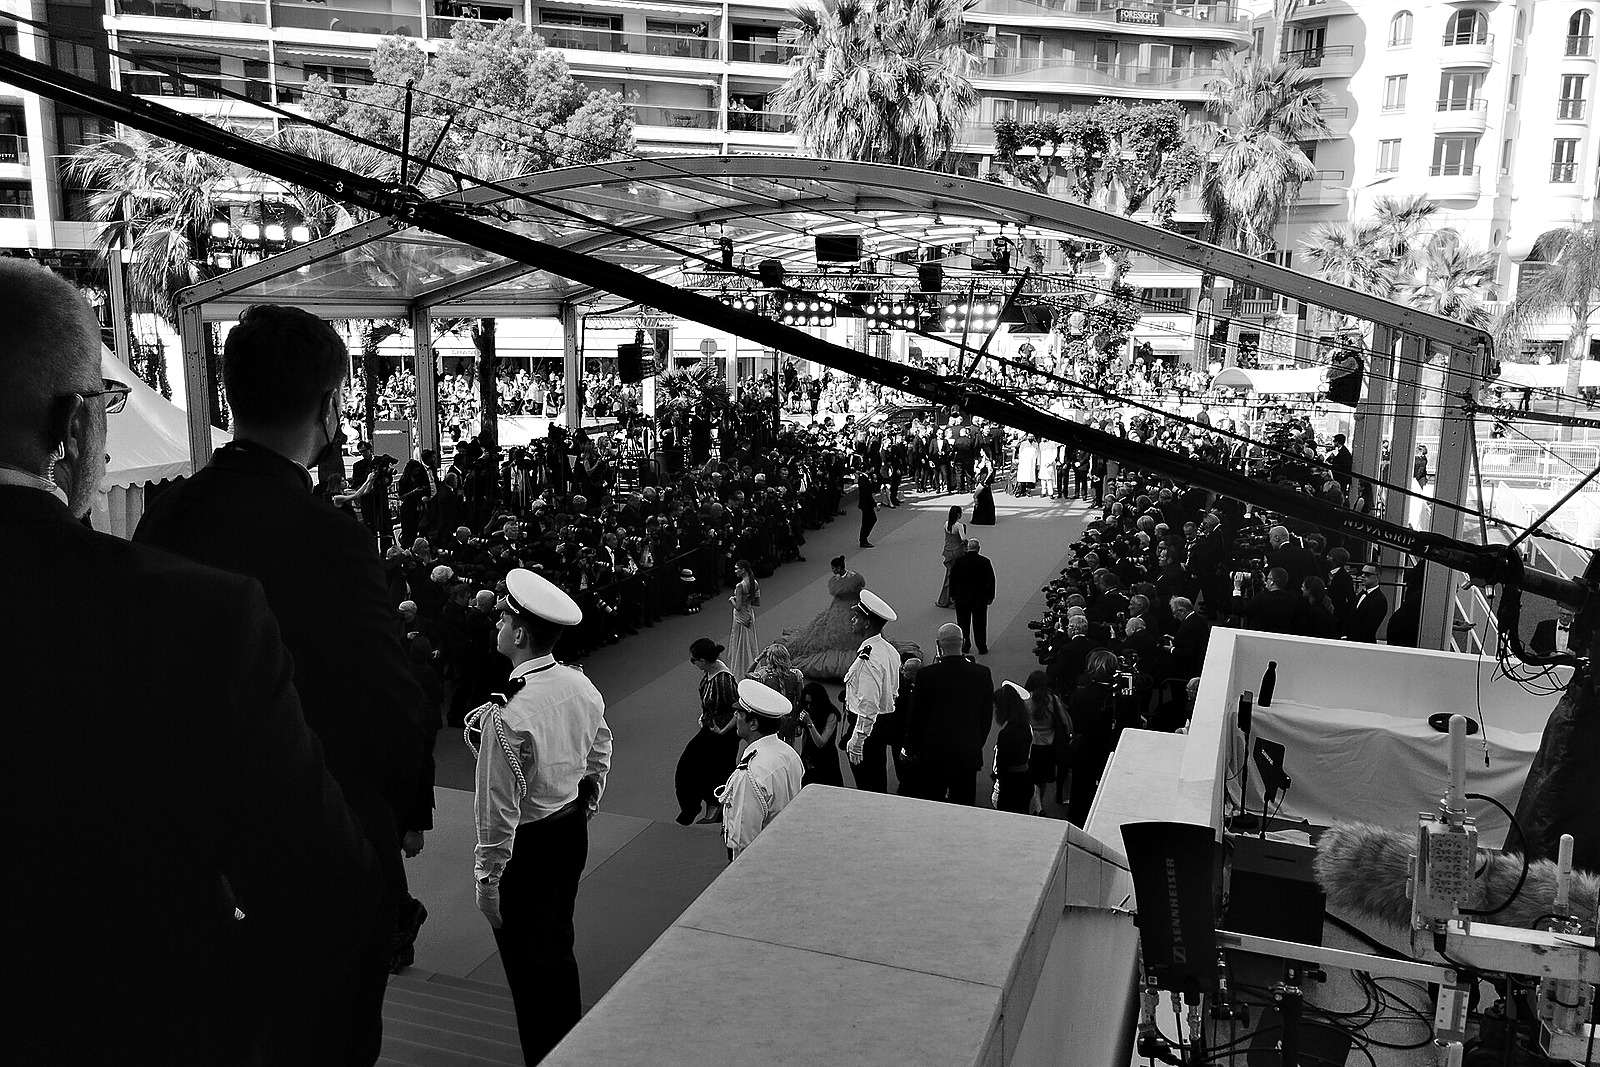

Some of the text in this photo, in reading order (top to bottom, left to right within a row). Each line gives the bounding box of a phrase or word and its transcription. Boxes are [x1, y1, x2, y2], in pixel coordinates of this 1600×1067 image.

[1121, 9, 1159, 20] FORESIGHT
[335, 181, 344, 193] 3
[901, 375, 910, 386] 2
[1166, 858, 1183, 943] SENNHEISER
